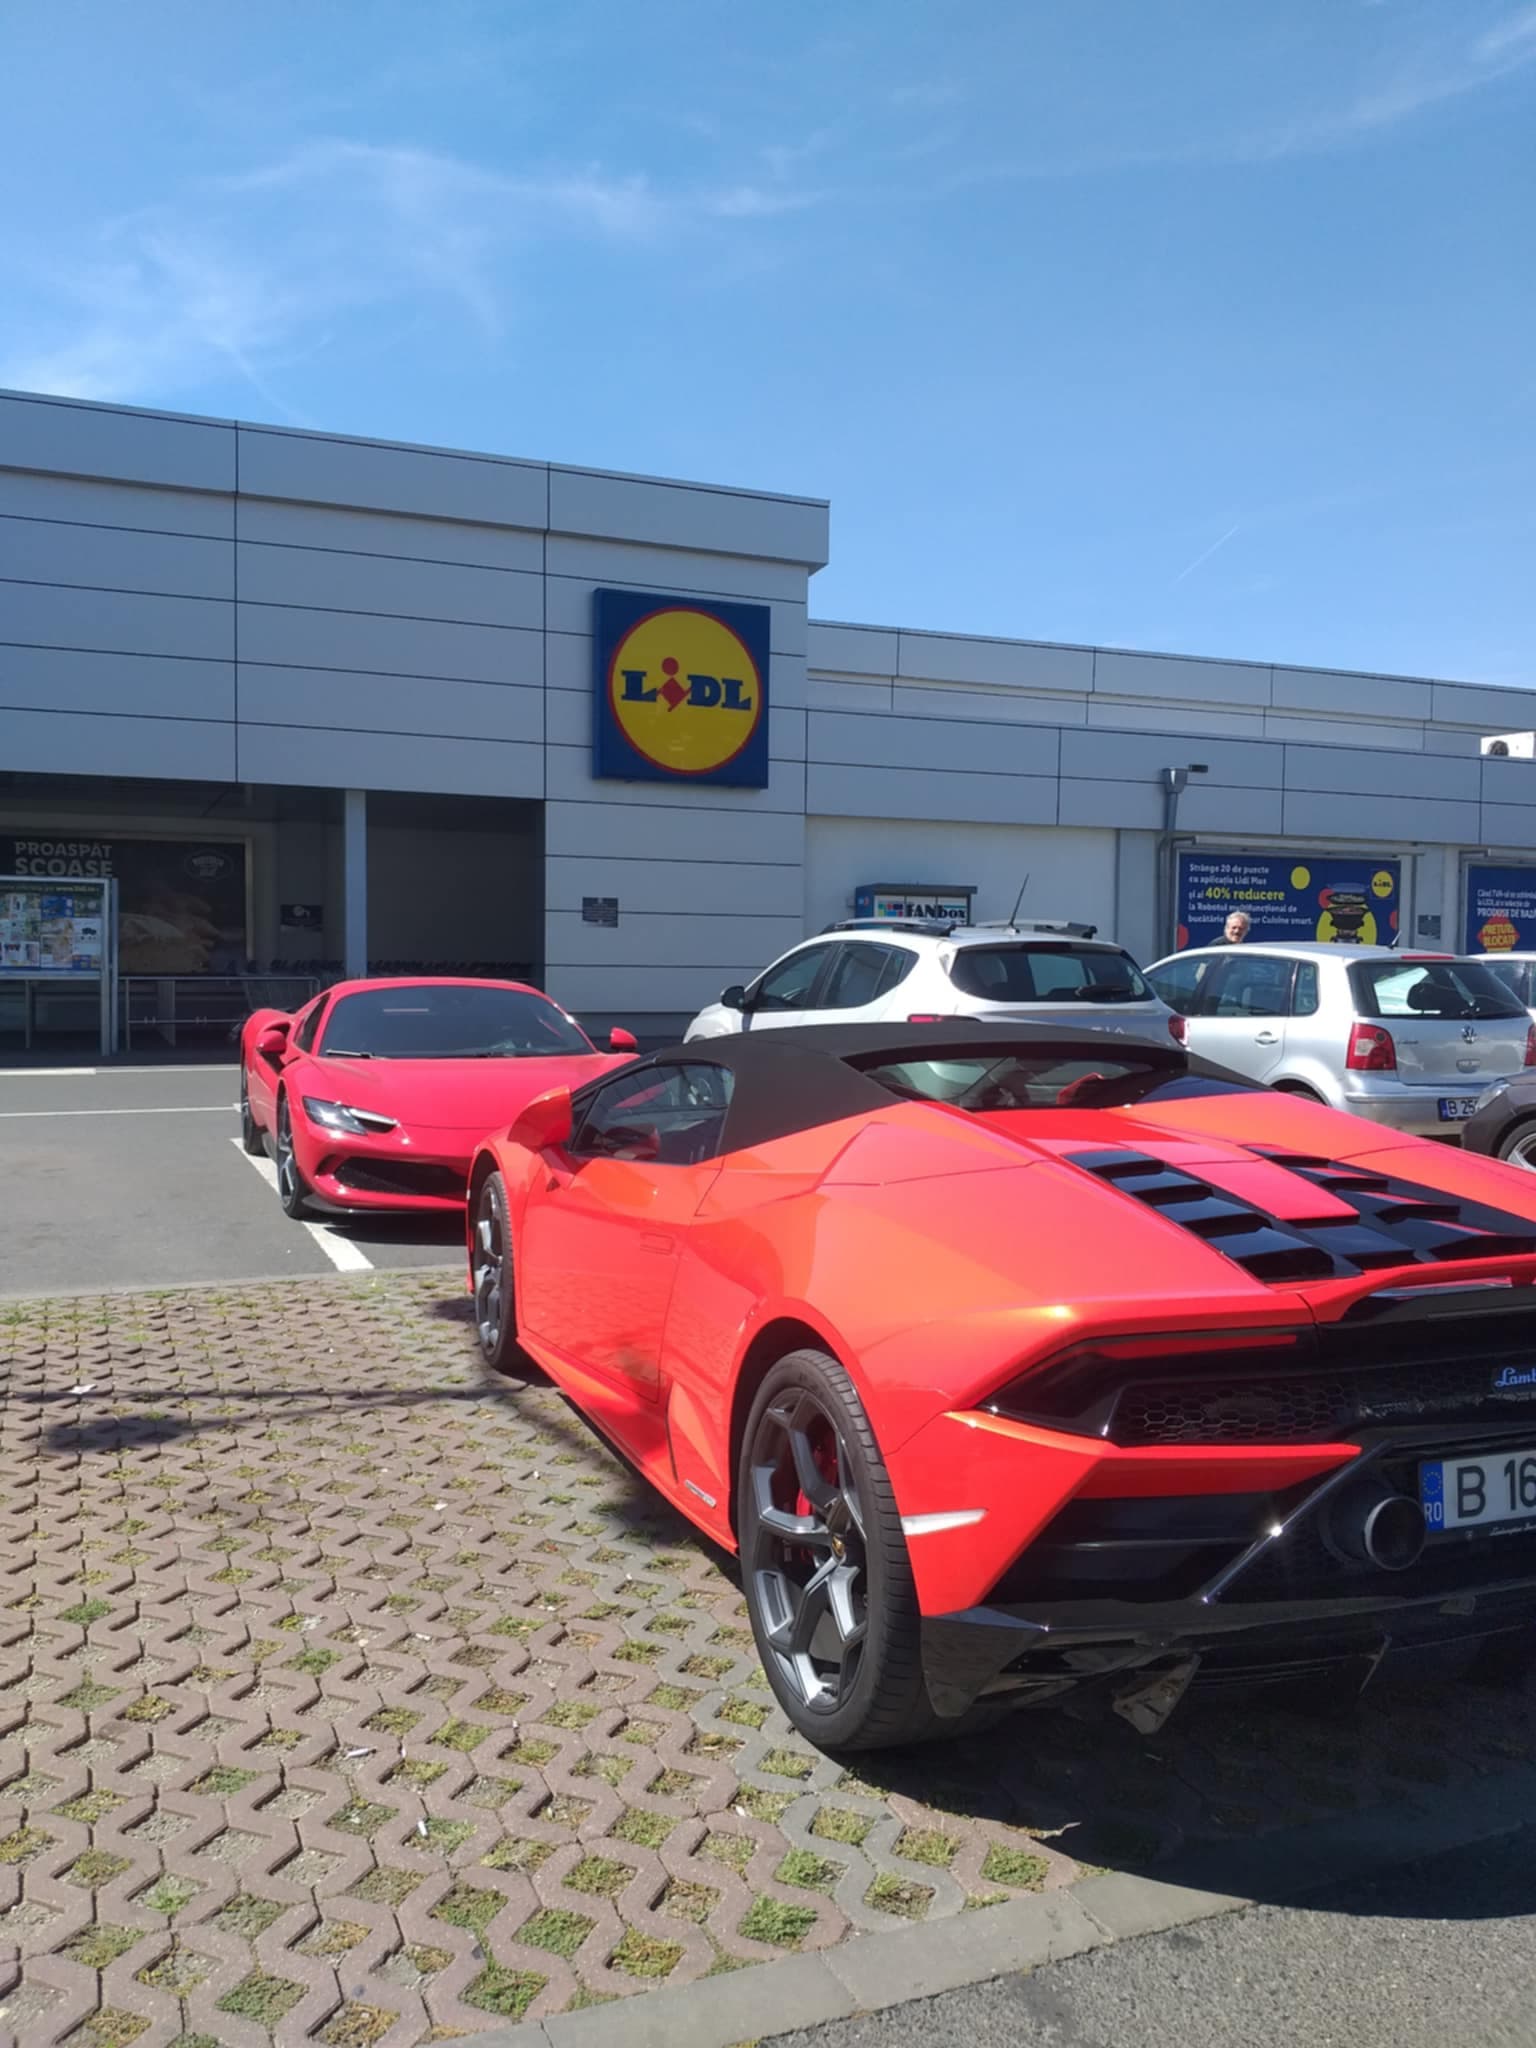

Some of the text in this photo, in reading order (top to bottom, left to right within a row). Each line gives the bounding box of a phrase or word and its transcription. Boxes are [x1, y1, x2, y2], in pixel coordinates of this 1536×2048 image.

[15, 857, 112, 877] SCOASE
[1221, 864, 1231, 873] 20
[1232, 864, 1242, 873] de
[1243, 866, 1269, 875] puncte
[1235, 876, 1249, 885] Lidl
[1251, 877, 1267, 885] Plus
[1206, 887, 1231, 900] 40%
[1234, 888, 1285, 901] reducere
[1448, 1100, 1457, 1115] B
[1461, 1100, 1479, 1115] 25
[1424, 1458, 1536, 1523] RO B 16
